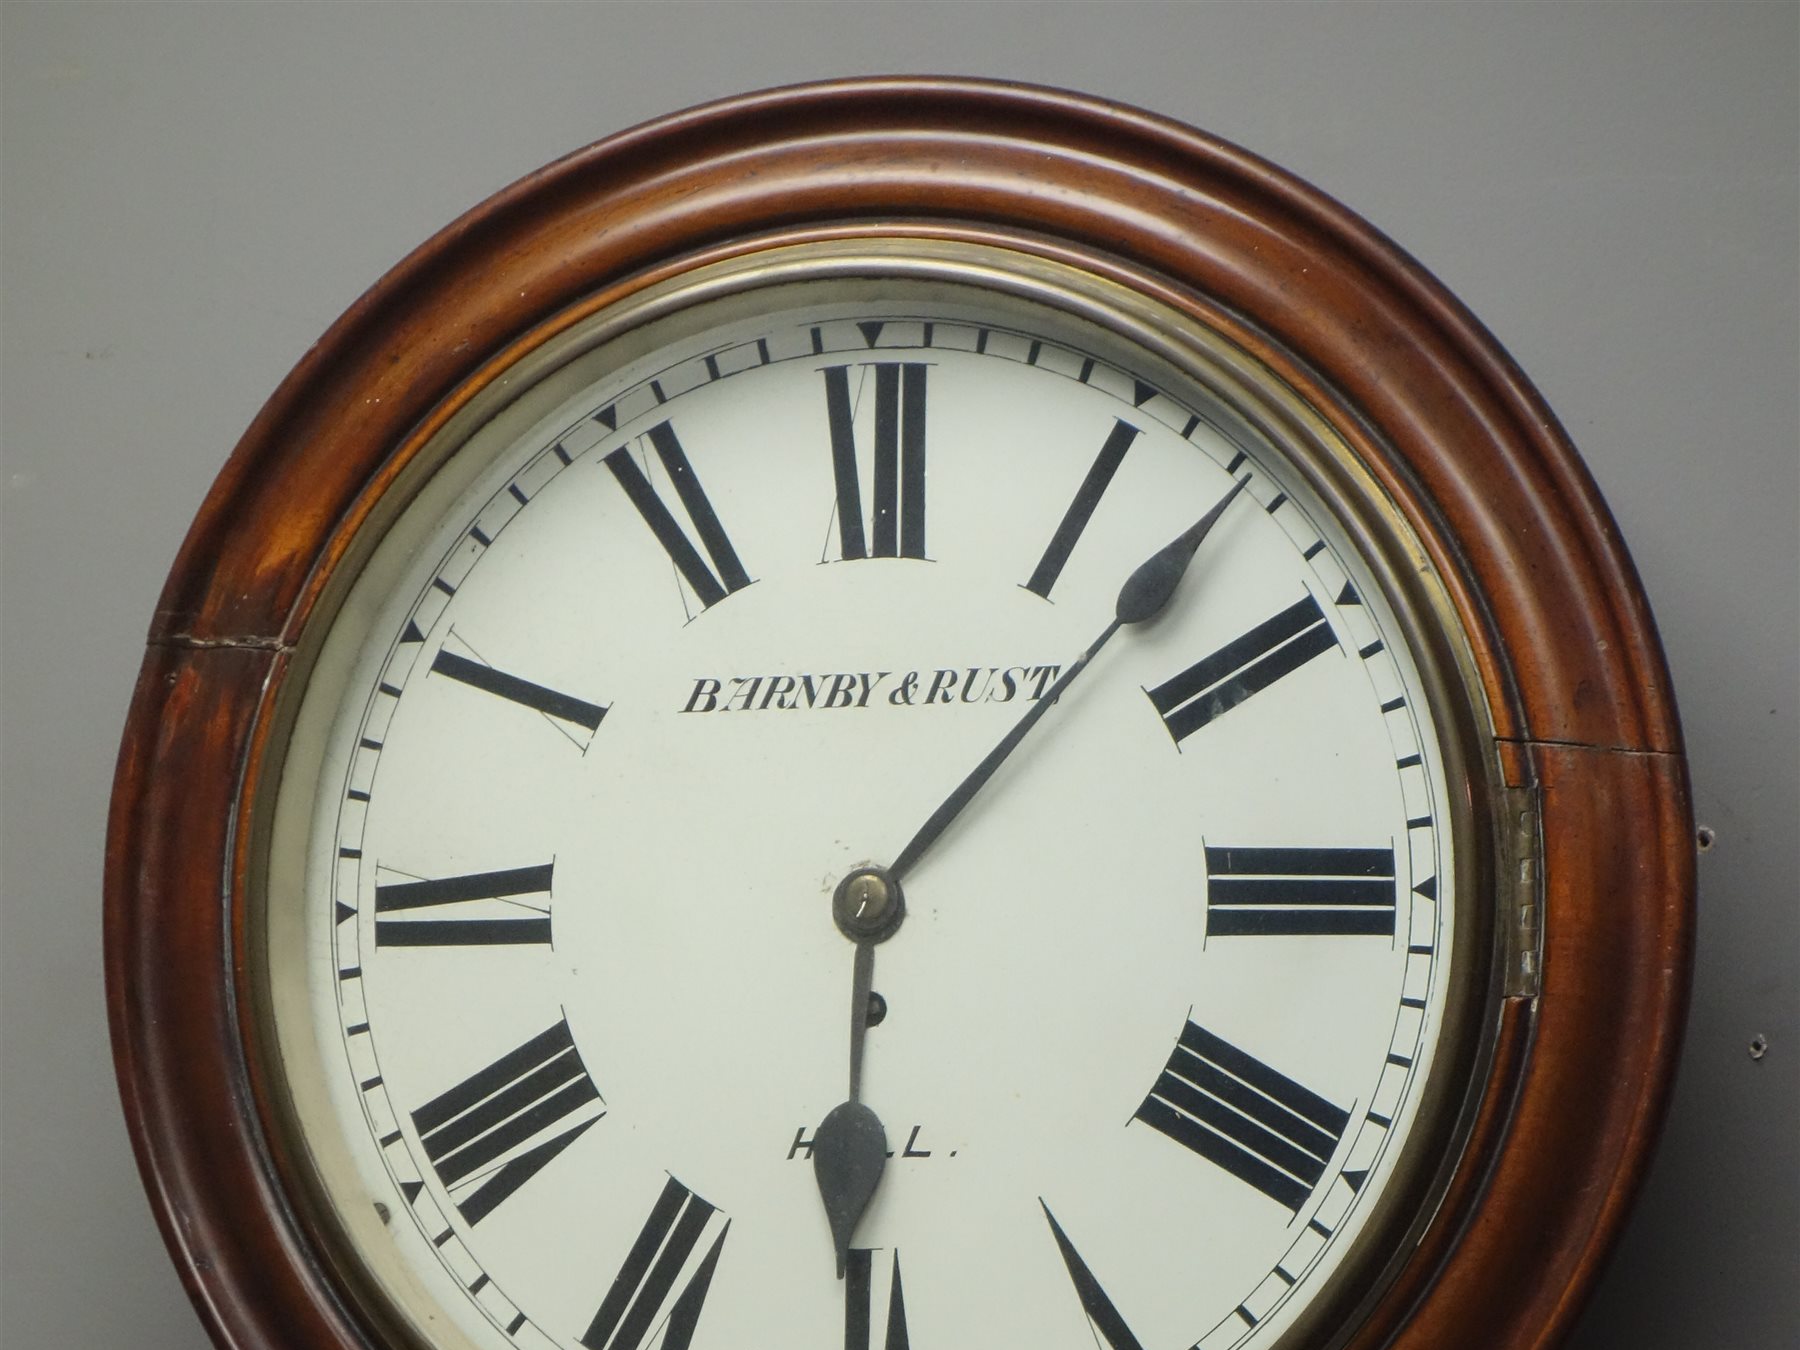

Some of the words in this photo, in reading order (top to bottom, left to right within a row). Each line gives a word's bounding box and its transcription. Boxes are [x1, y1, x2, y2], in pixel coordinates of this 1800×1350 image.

[597, 416, 761, 628] XI
[815, 362, 938, 565] XII
[1016, 415, 1147, 605] I
[426, 622, 615, 758] X
[1140, 580, 1347, 754] II
[374, 853, 556, 953] IX
[1201, 834, 1397, 952] III
[409, 1003, 608, 1230] VIII
[785, 1125, 958, 1160] HL.
[1125, 1003, 1359, 1229] IIII
